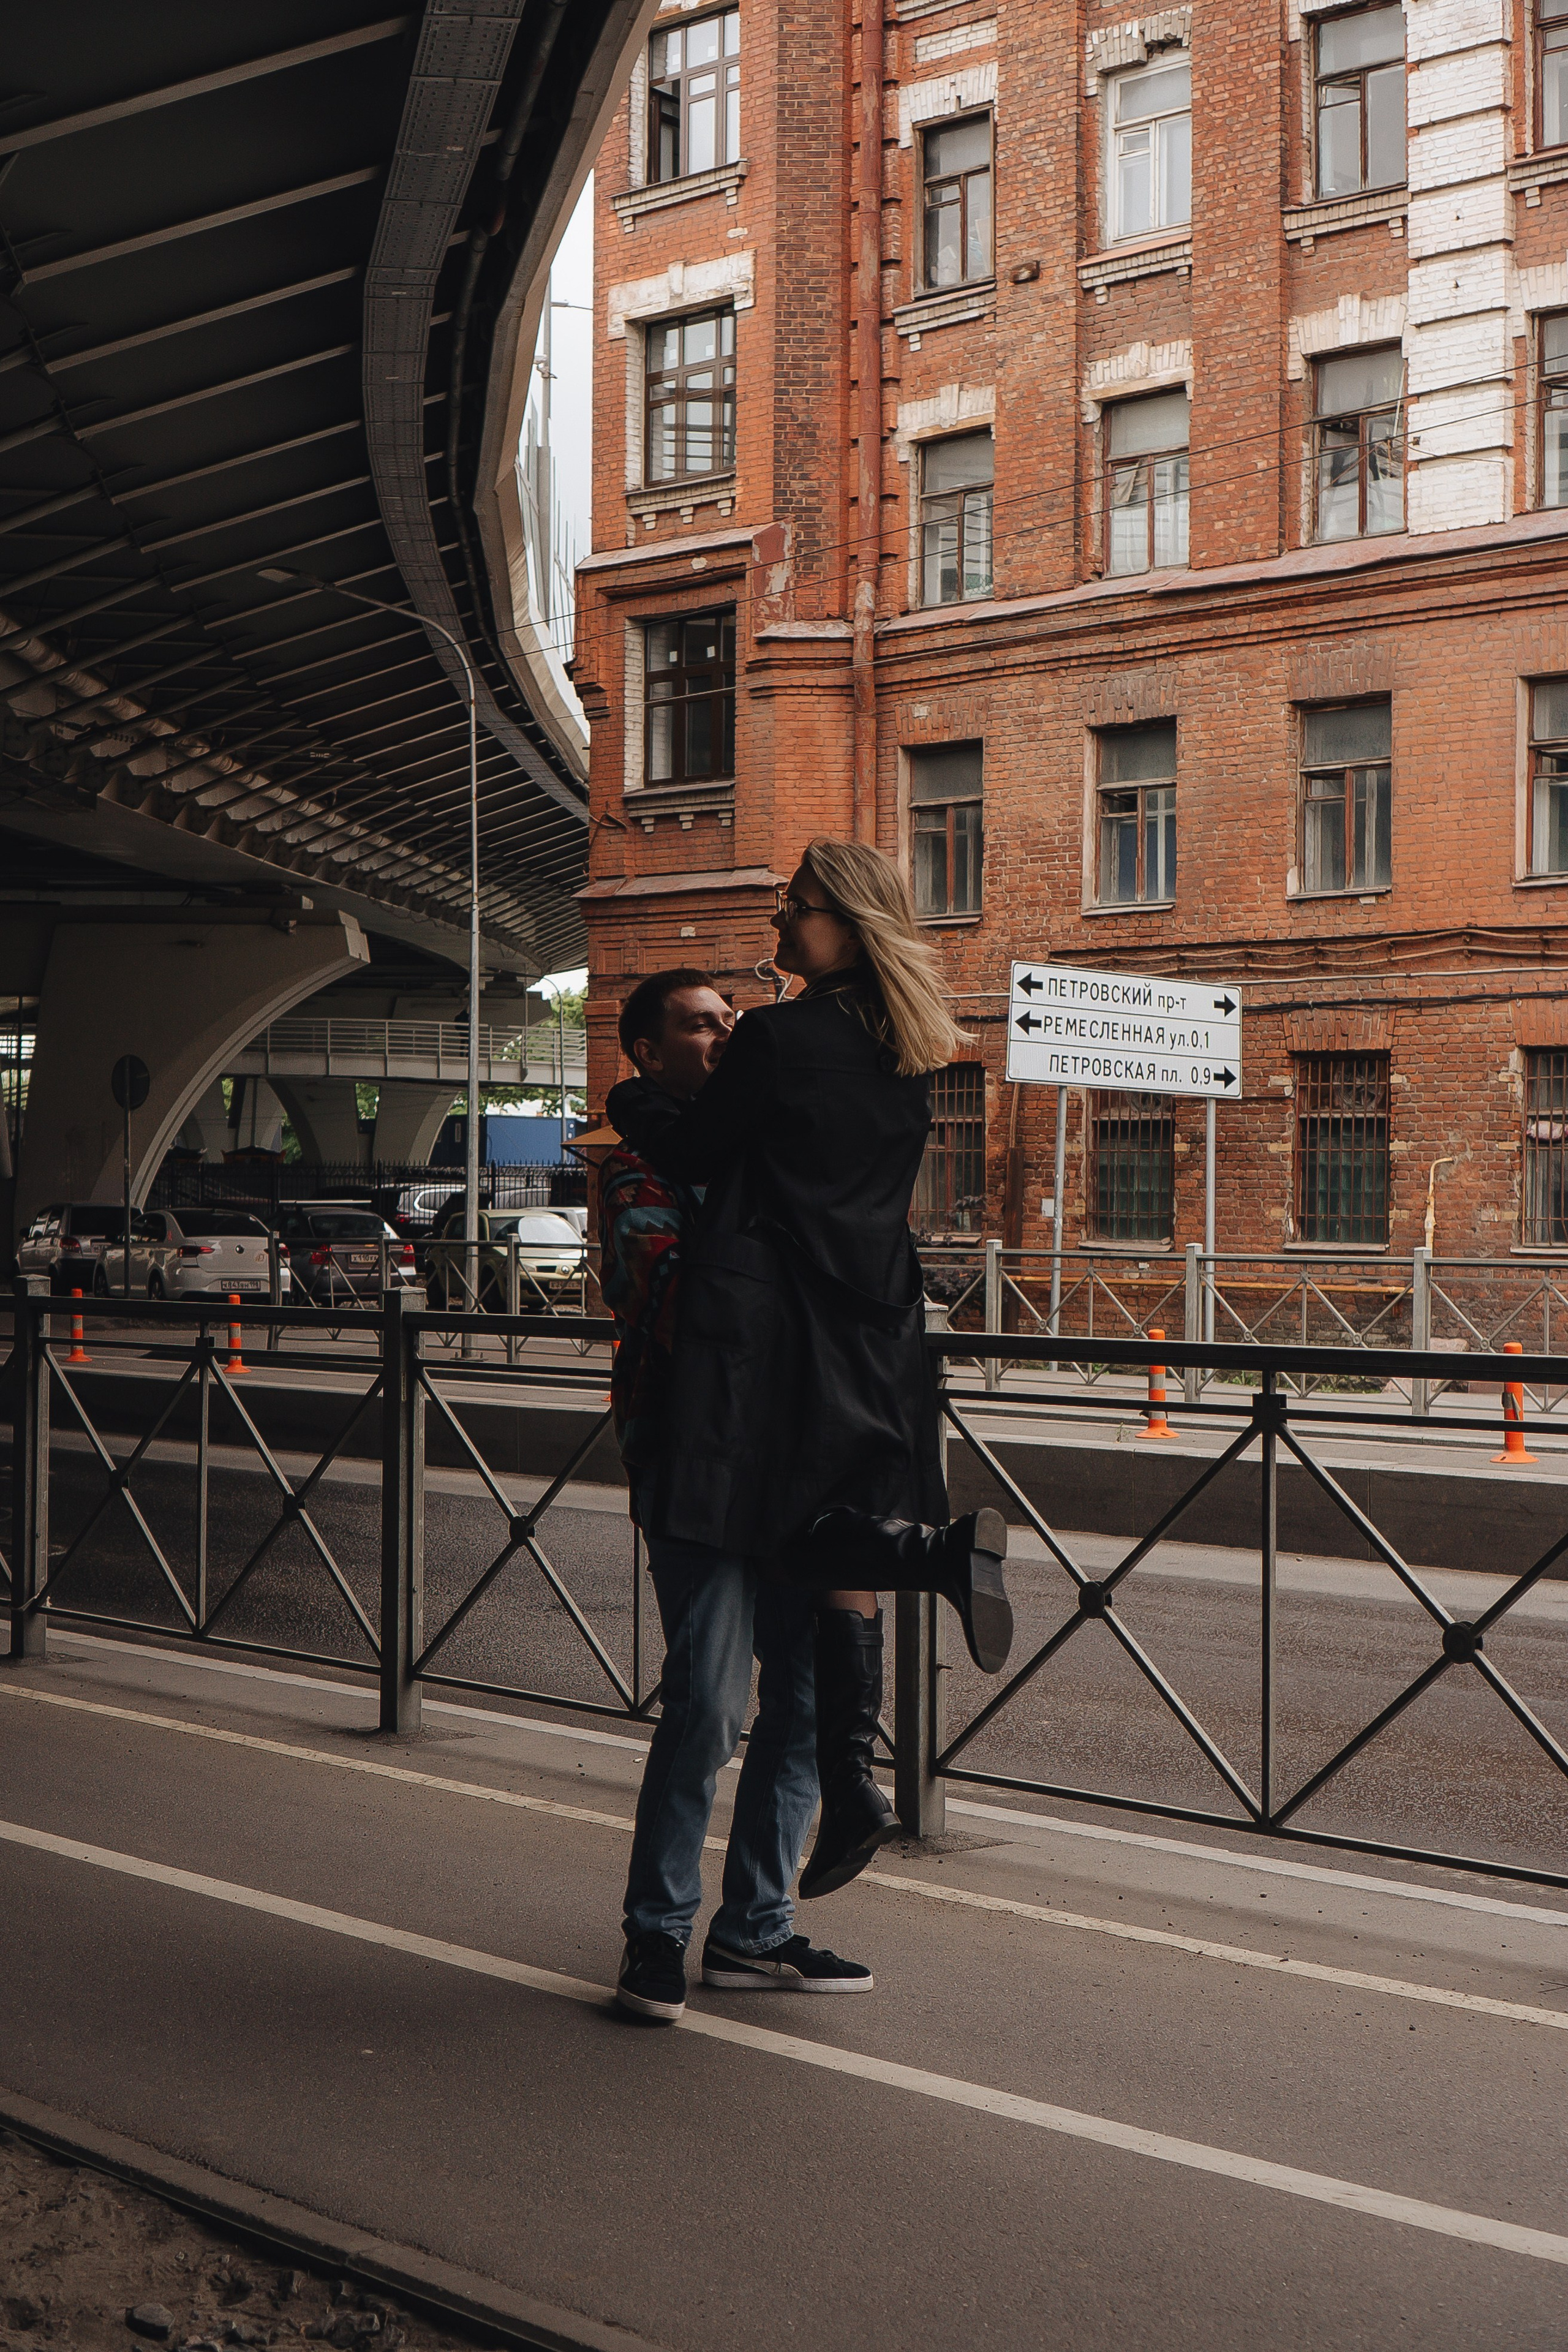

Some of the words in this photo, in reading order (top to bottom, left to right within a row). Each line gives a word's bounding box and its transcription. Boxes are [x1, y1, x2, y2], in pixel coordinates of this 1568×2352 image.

[1048, 978, 1152, 1006] ПЕТРОВСКИЙ
[1158, 995, 1187, 1013] пр-т
[1043, 1015, 1164, 1044] РЕМЕСЛЕННАЯ
[1049, 1054, 1156, 1081] ПЕТРОВСКАЯ
[1161, 1069, 1182, 1083] пл.
[1191, 1066, 1211, 1087] 0,9
